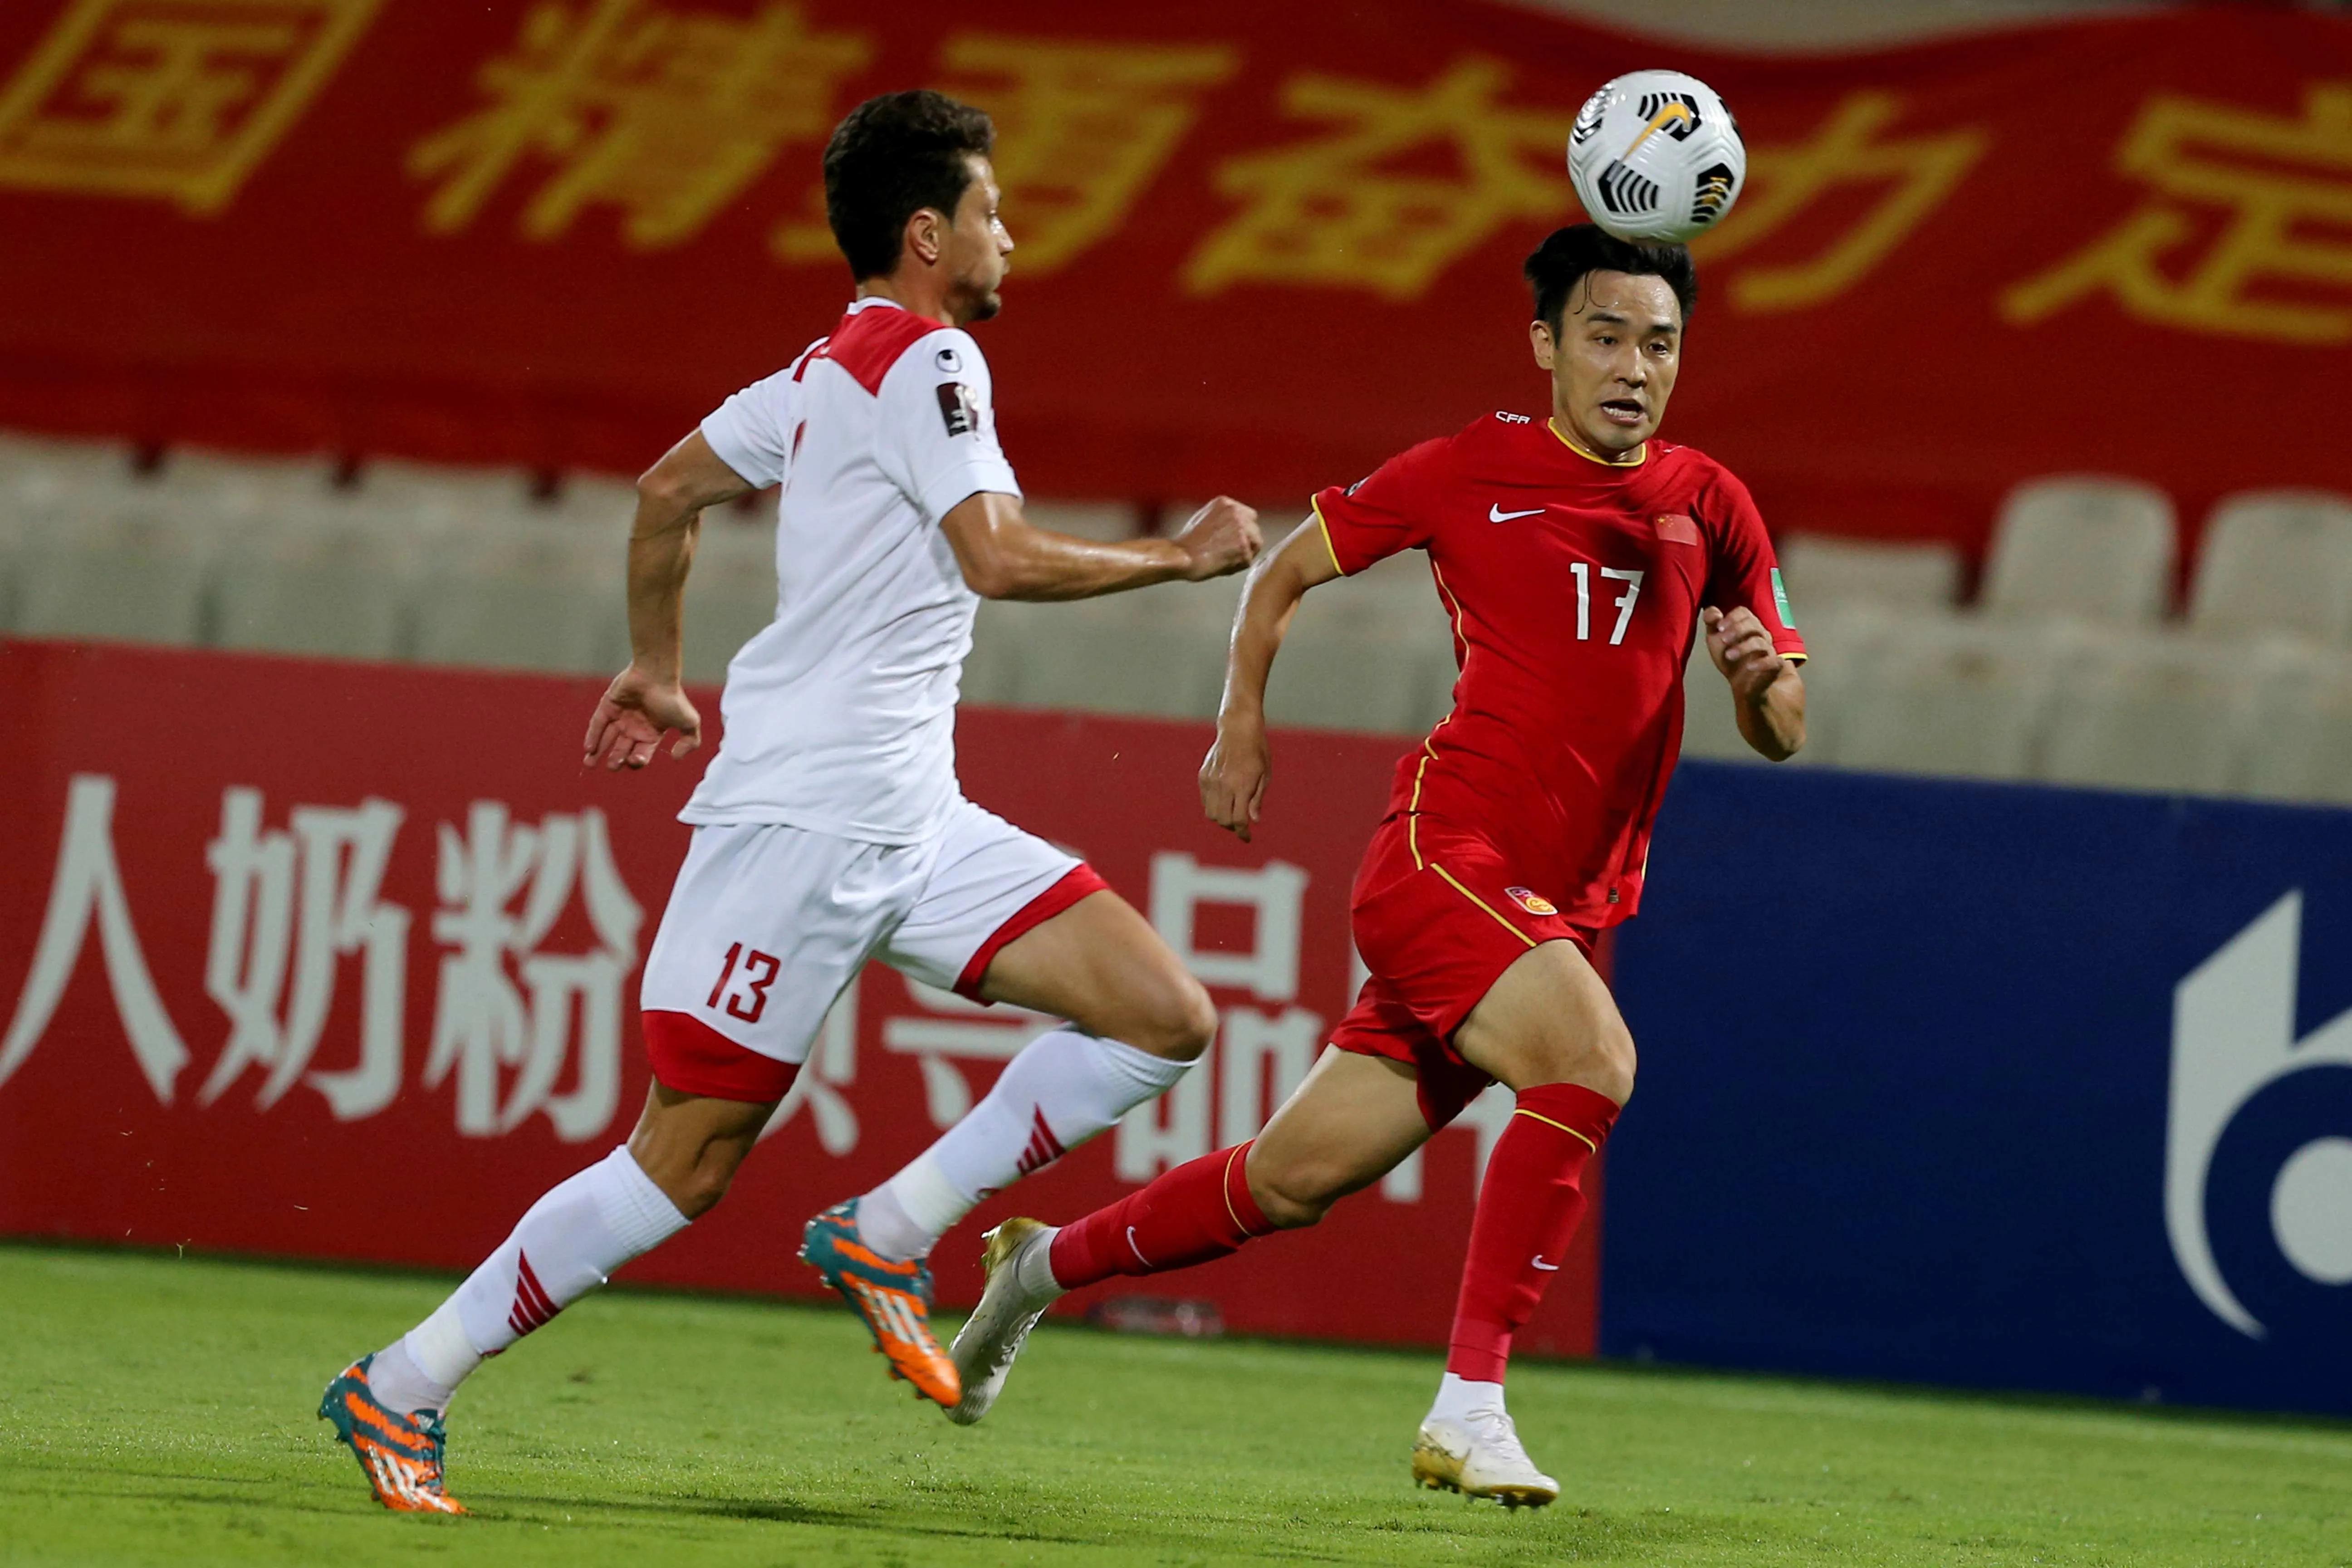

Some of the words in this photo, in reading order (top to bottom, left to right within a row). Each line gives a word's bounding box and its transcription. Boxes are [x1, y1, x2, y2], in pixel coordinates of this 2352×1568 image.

[1495, 411, 1531, 424] CFA
[1570, 563, 1644, 645] 17
[706, 941, 781, 1024] 13
